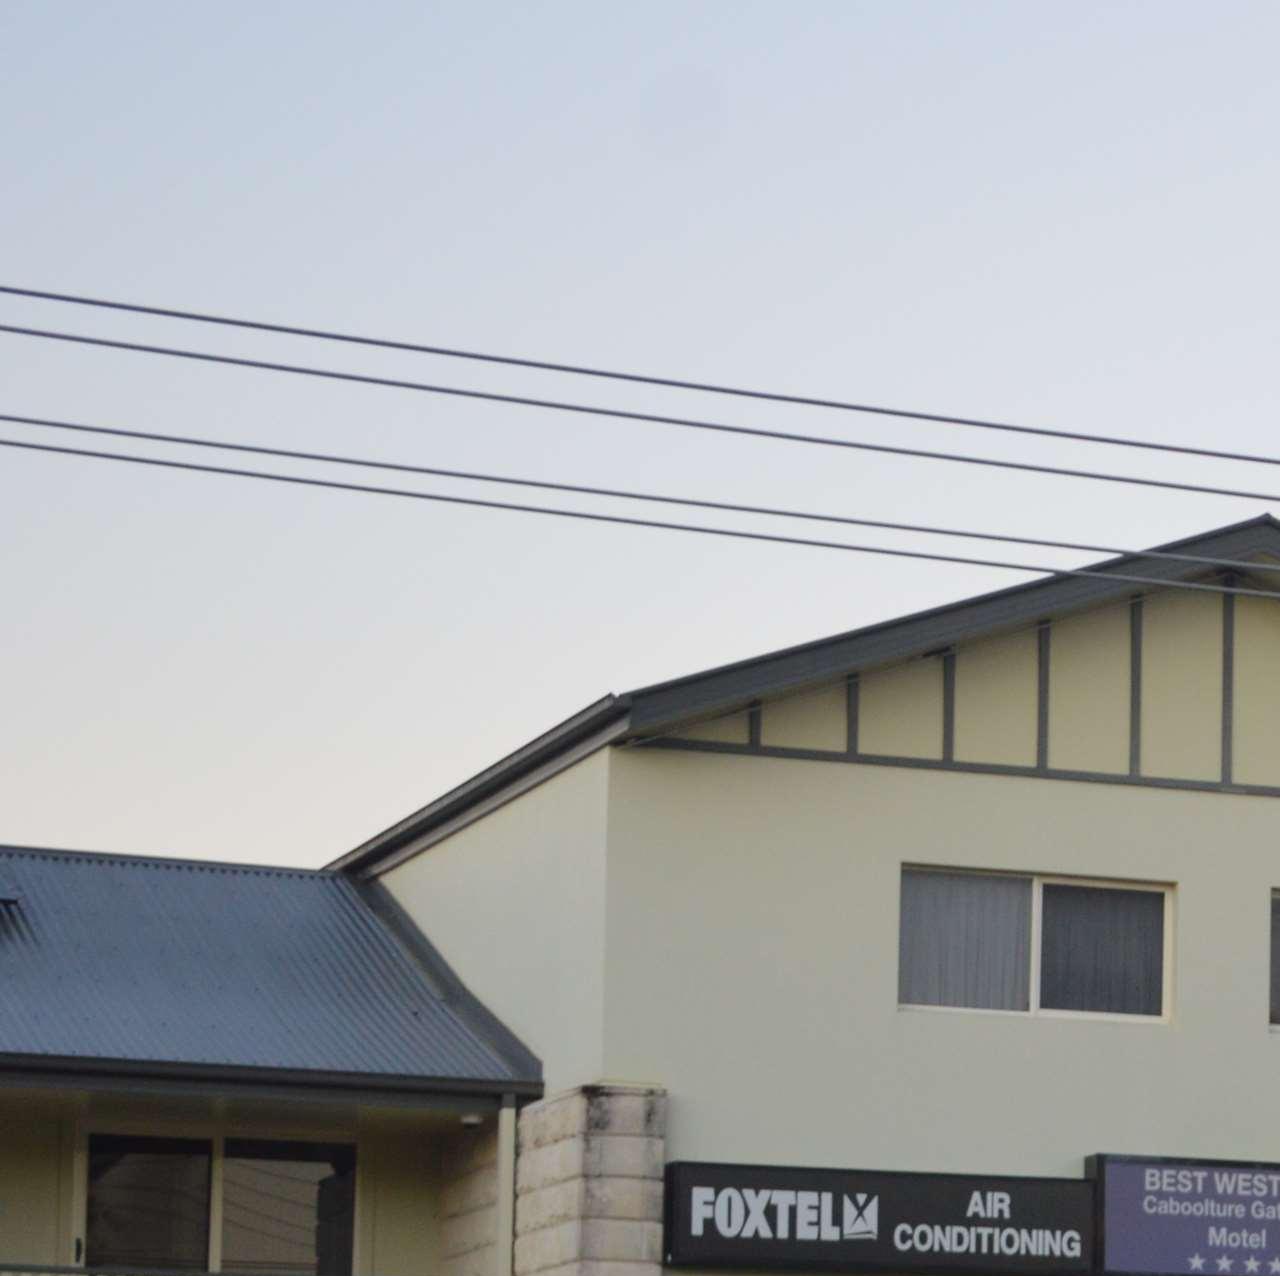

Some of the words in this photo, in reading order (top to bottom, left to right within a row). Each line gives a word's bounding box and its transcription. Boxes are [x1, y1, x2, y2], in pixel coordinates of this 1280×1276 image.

[1143, 1168, 1207, 1193] BEST
[690, 1186, 840, 1241] FOXTEL
[966, 1190, 1012, 1219] AIR
[1143, 1195, 1246, 1218] Caboolture
[893, 1223, 1082, 1258] CONDITIONING
[1207, 1226, 1268, 1249] Motel
